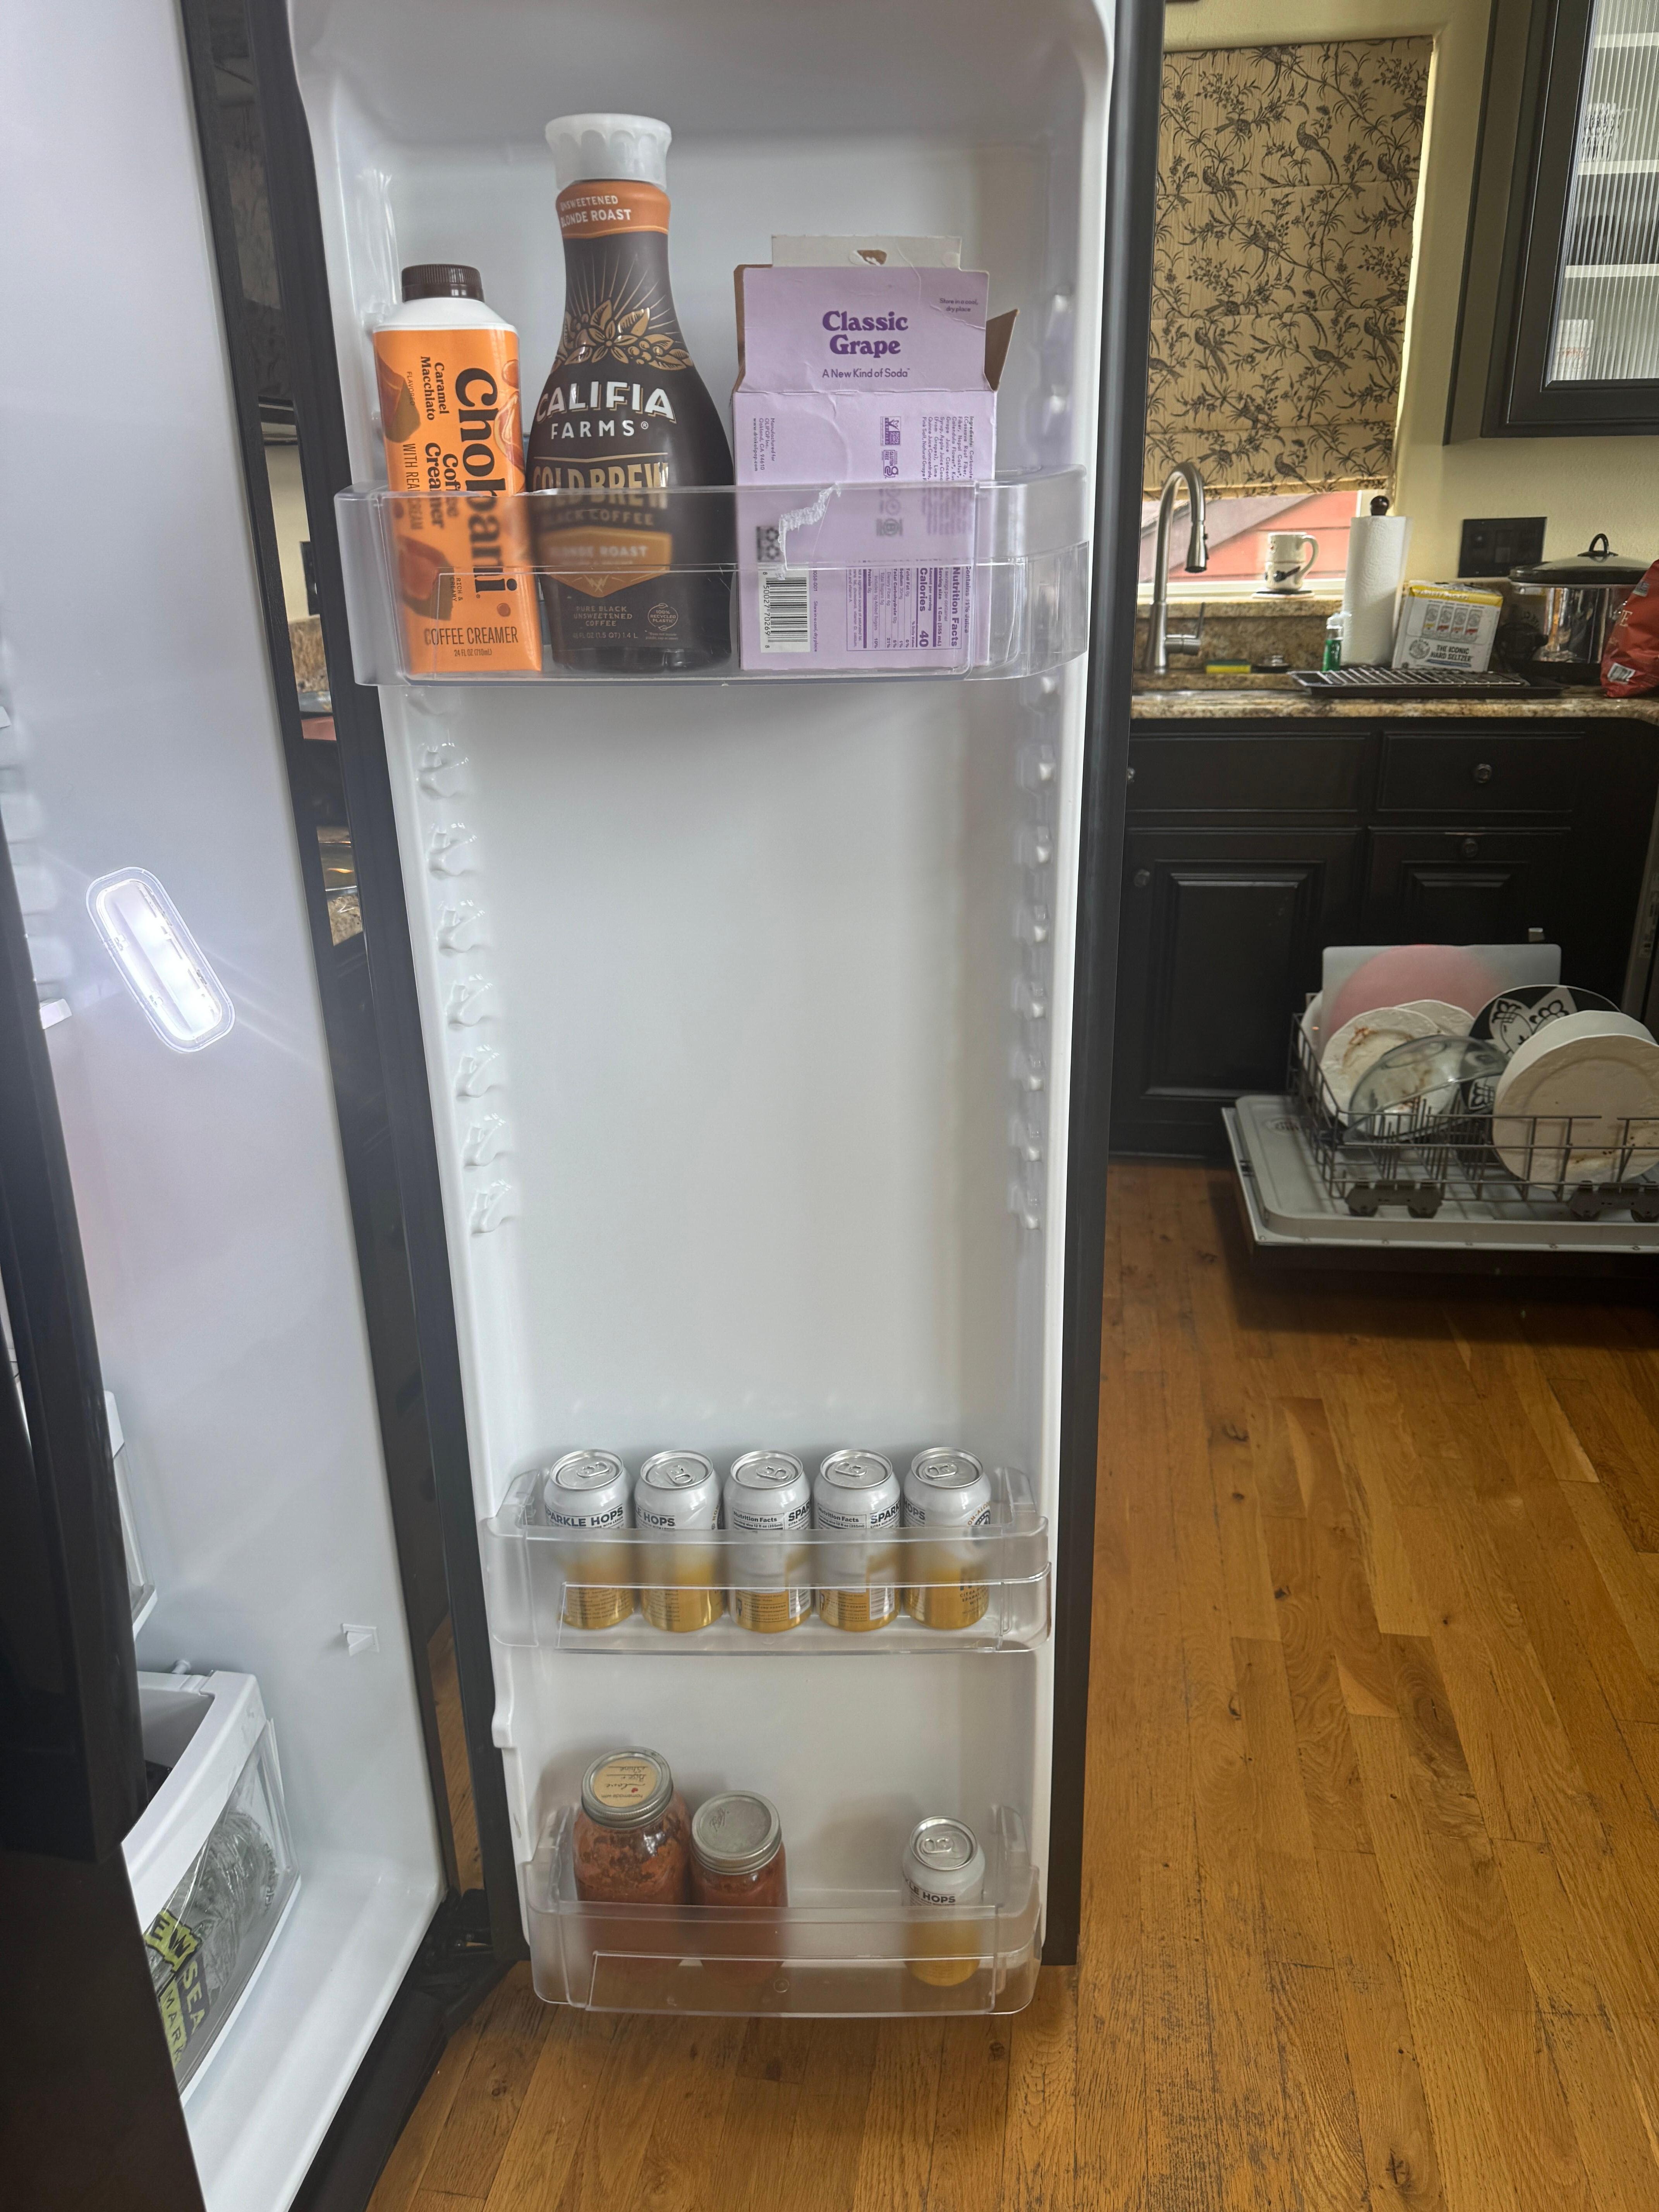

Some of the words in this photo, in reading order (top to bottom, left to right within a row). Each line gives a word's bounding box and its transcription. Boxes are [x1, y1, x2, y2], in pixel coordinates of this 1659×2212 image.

[591, 209, 631, 221] ROAST
[822, 311, 908, 331] Classic
[830, 334, 901, 358] Grape
[822, 369, 830, 378] A
[831, 369, 852, 378] New
[853, 368, 873, 378] Kind
[874, 368, 883, 378] of
[421, 356, 435, 420] Macchiato
[434, 362, 449, 414] Caramel
[537, 381, 675, 422] CALIFIA
[403, 443, 417, 467] WITH
[760, 444, 764, 452] CA
[590, 462, 668, 509] BREW
[952, 567, 960, 614] Nutrition
[424, 628, 464, 645] COFFEE
[467, 626, 519, 644] CREAMER
[920, 630, 929, 647] 40
[951, 618, 960, 647] Facts
[546, 1508, 586, 1527] PARKLE
[591, 1507, 623, 1526] HOPS
[644, 1512, 675, 1526] HOPS
[733, 1511, 758, 1522] Nutrition
[923, 1891, 955, 1903] HOPS
[183, 1960, 205, 2036] SEA
